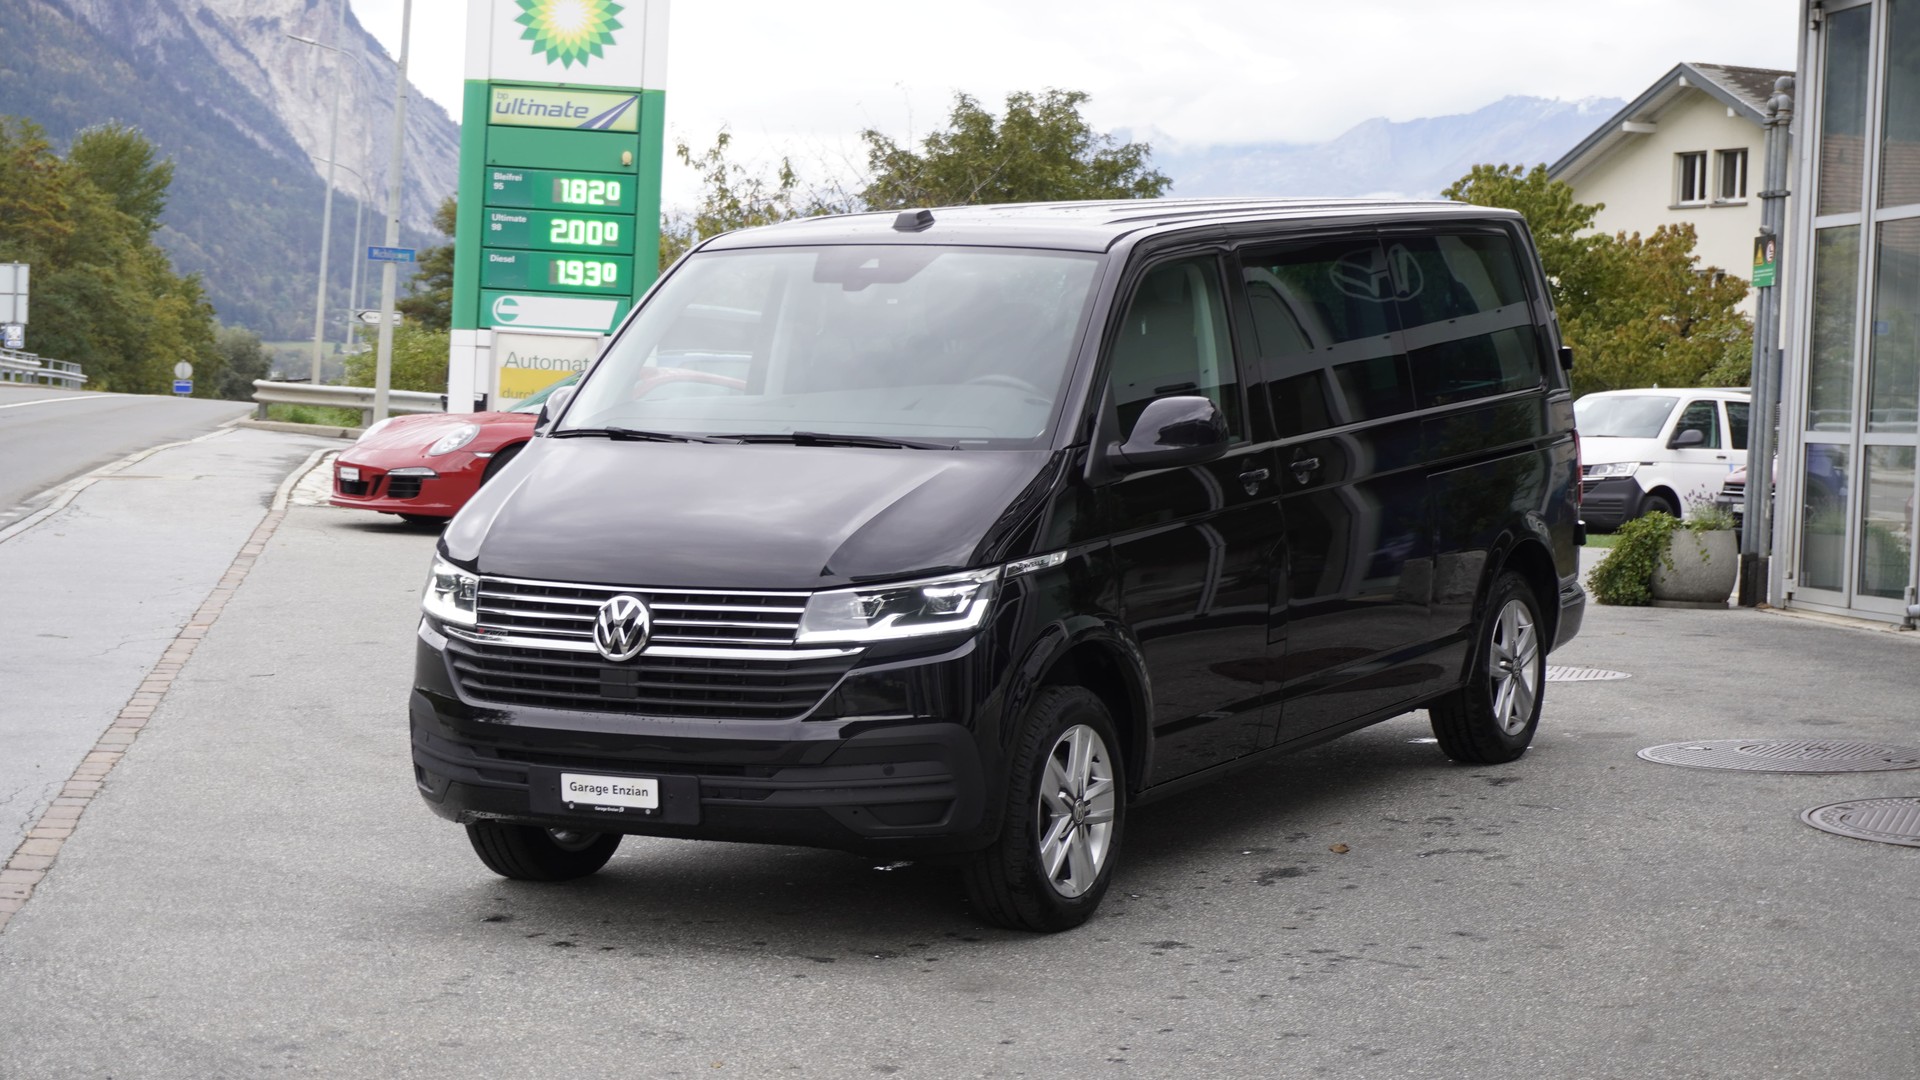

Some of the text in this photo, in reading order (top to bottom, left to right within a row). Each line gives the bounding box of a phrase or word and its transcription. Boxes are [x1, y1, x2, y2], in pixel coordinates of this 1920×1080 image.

[495, 98, 589, 119] ultimate
[493, 172, 523, 182] Bleifrei
[493, 182, 504, 190] 95
[491, 213, 528, 223] Ultimate
[489, 254, 516, 263] Diesel
[569, 781, 649, 797] Garage Enzian
